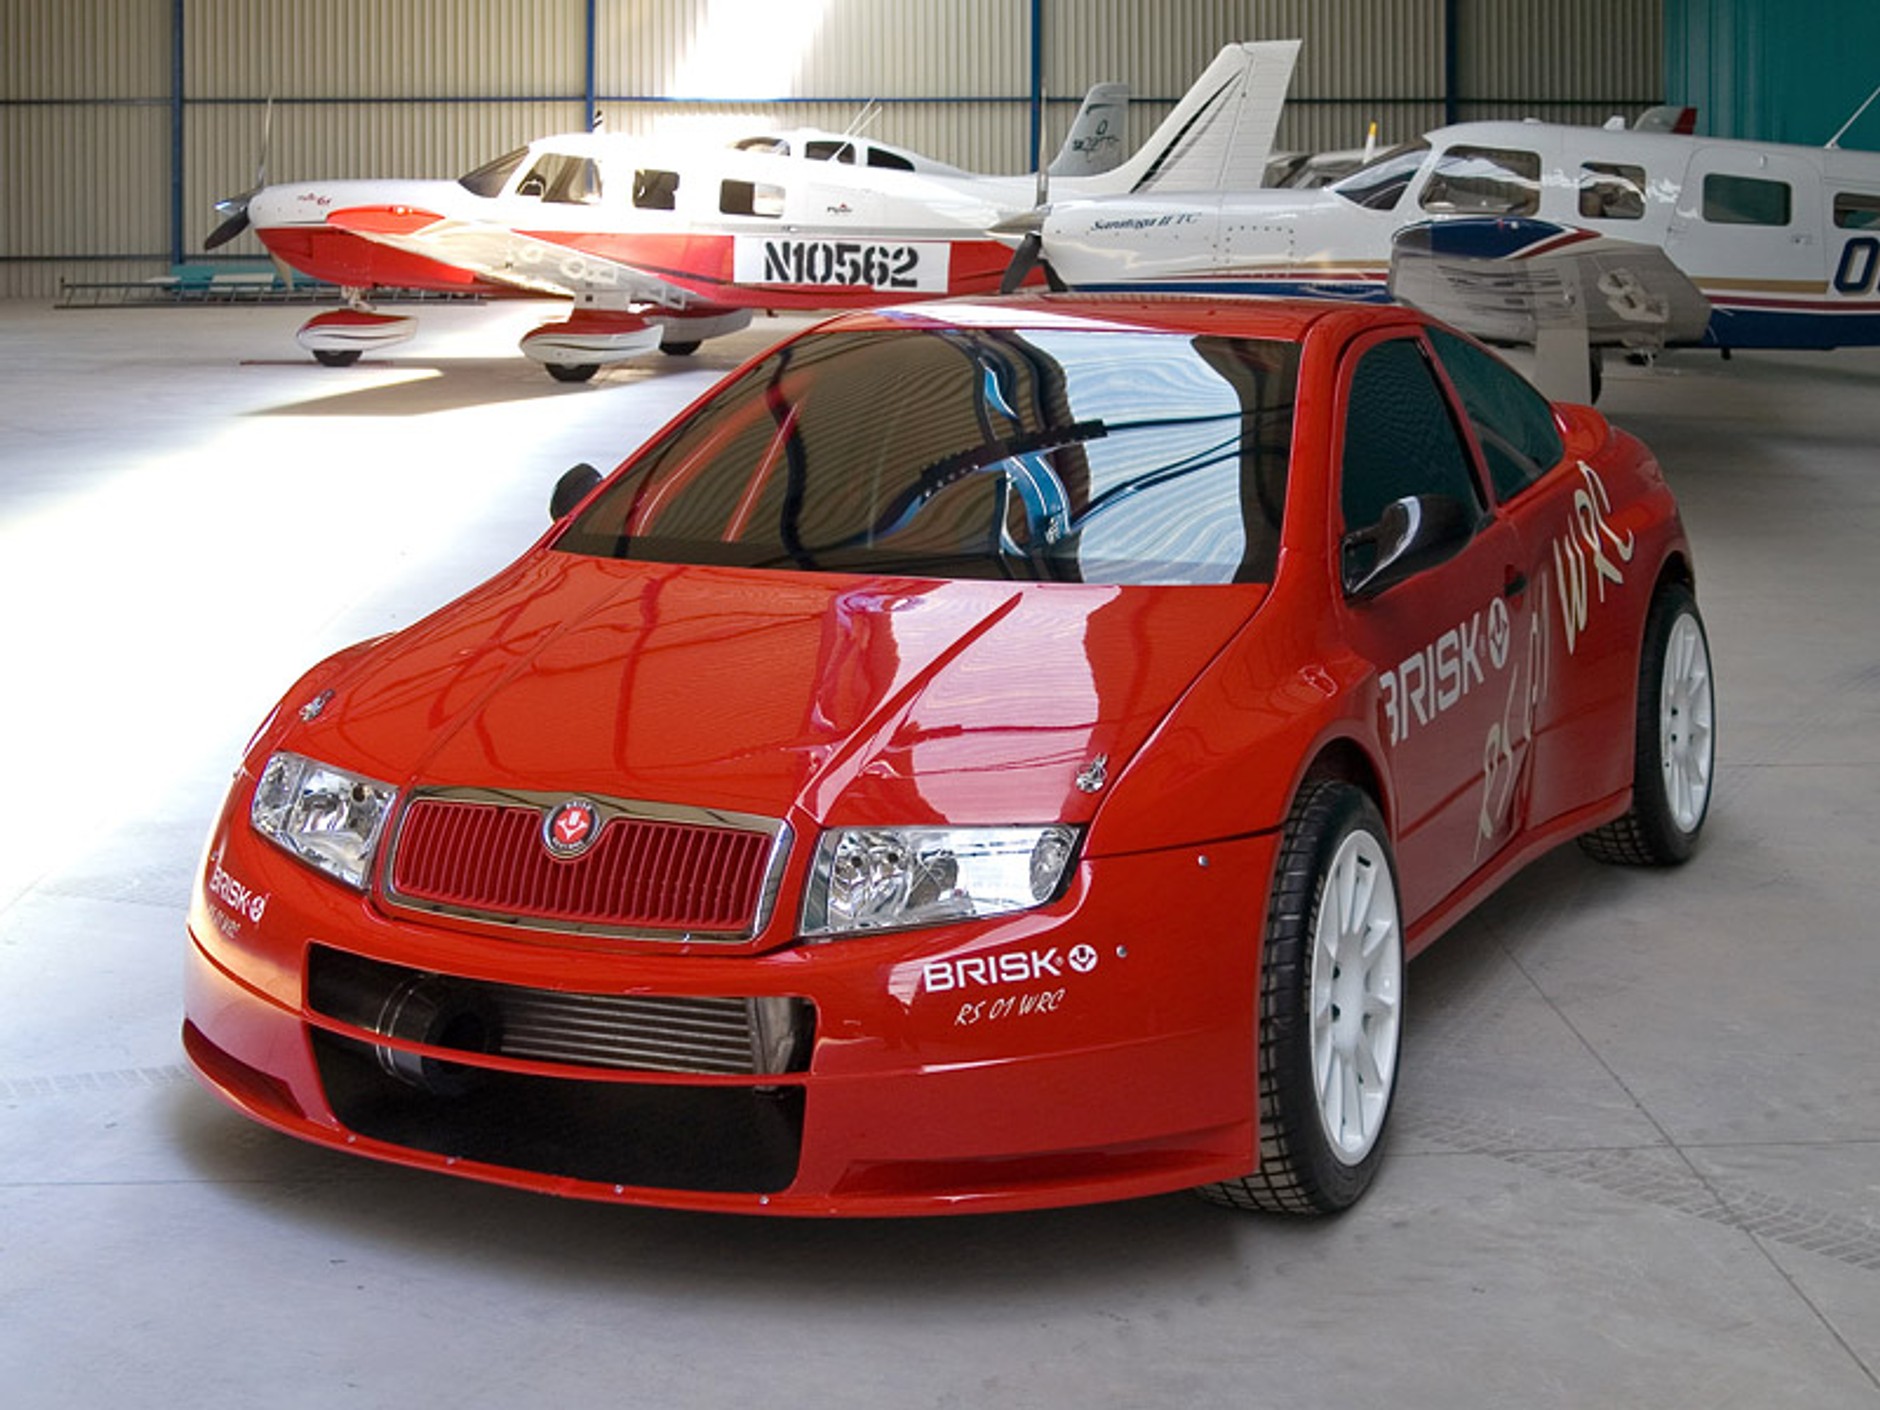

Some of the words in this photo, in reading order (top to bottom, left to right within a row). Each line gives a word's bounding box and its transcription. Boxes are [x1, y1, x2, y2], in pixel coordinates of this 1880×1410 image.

[764, 241, 919, 288] N10562
[1554, 460, 1635, 655] WRC
[1379, 611, 1484, 747] BRISK
[209, 866, 252, 915] BRISK
[923, 948, 1061, 992] BRISK
[954, 1000, 987, 1026] RS
[1018, 988, 1066, 1016] WRC
